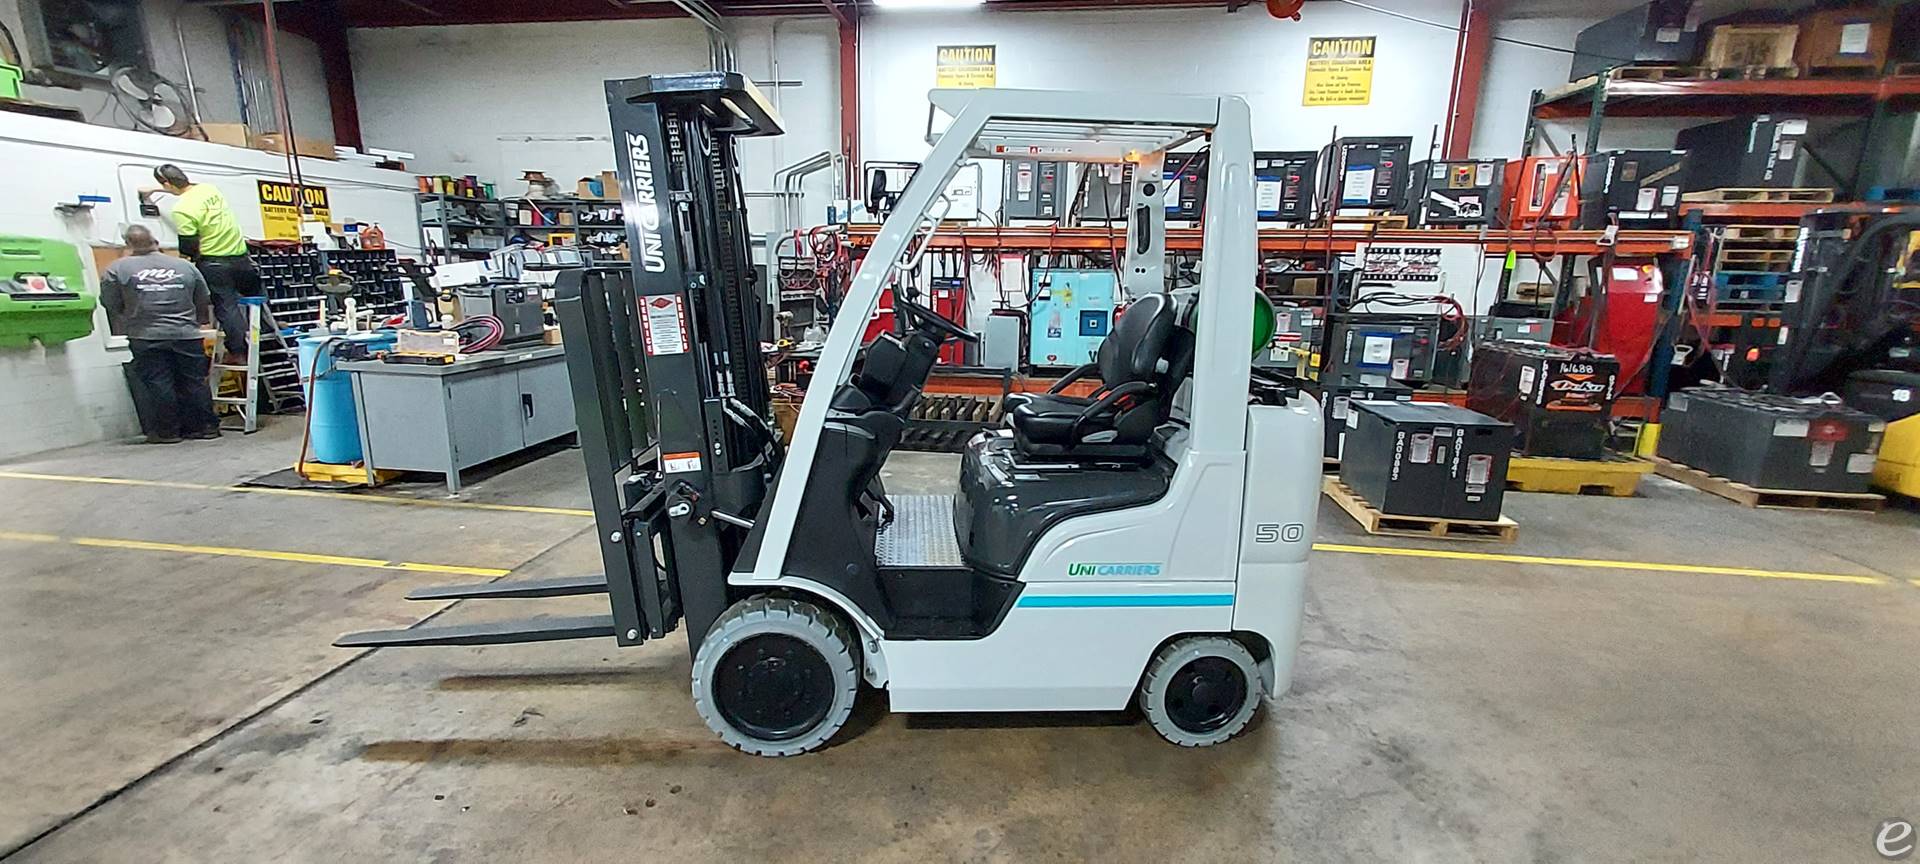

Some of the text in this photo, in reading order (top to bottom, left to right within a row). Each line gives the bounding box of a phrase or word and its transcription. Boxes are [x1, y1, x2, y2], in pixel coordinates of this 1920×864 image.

[939, 47, 993, 62] CAUTION
[1312, 39, 1373, 56] CAUTION
[261, 183, 325, 206] CAUTON
[1255, 523, 1305, 543] 50
